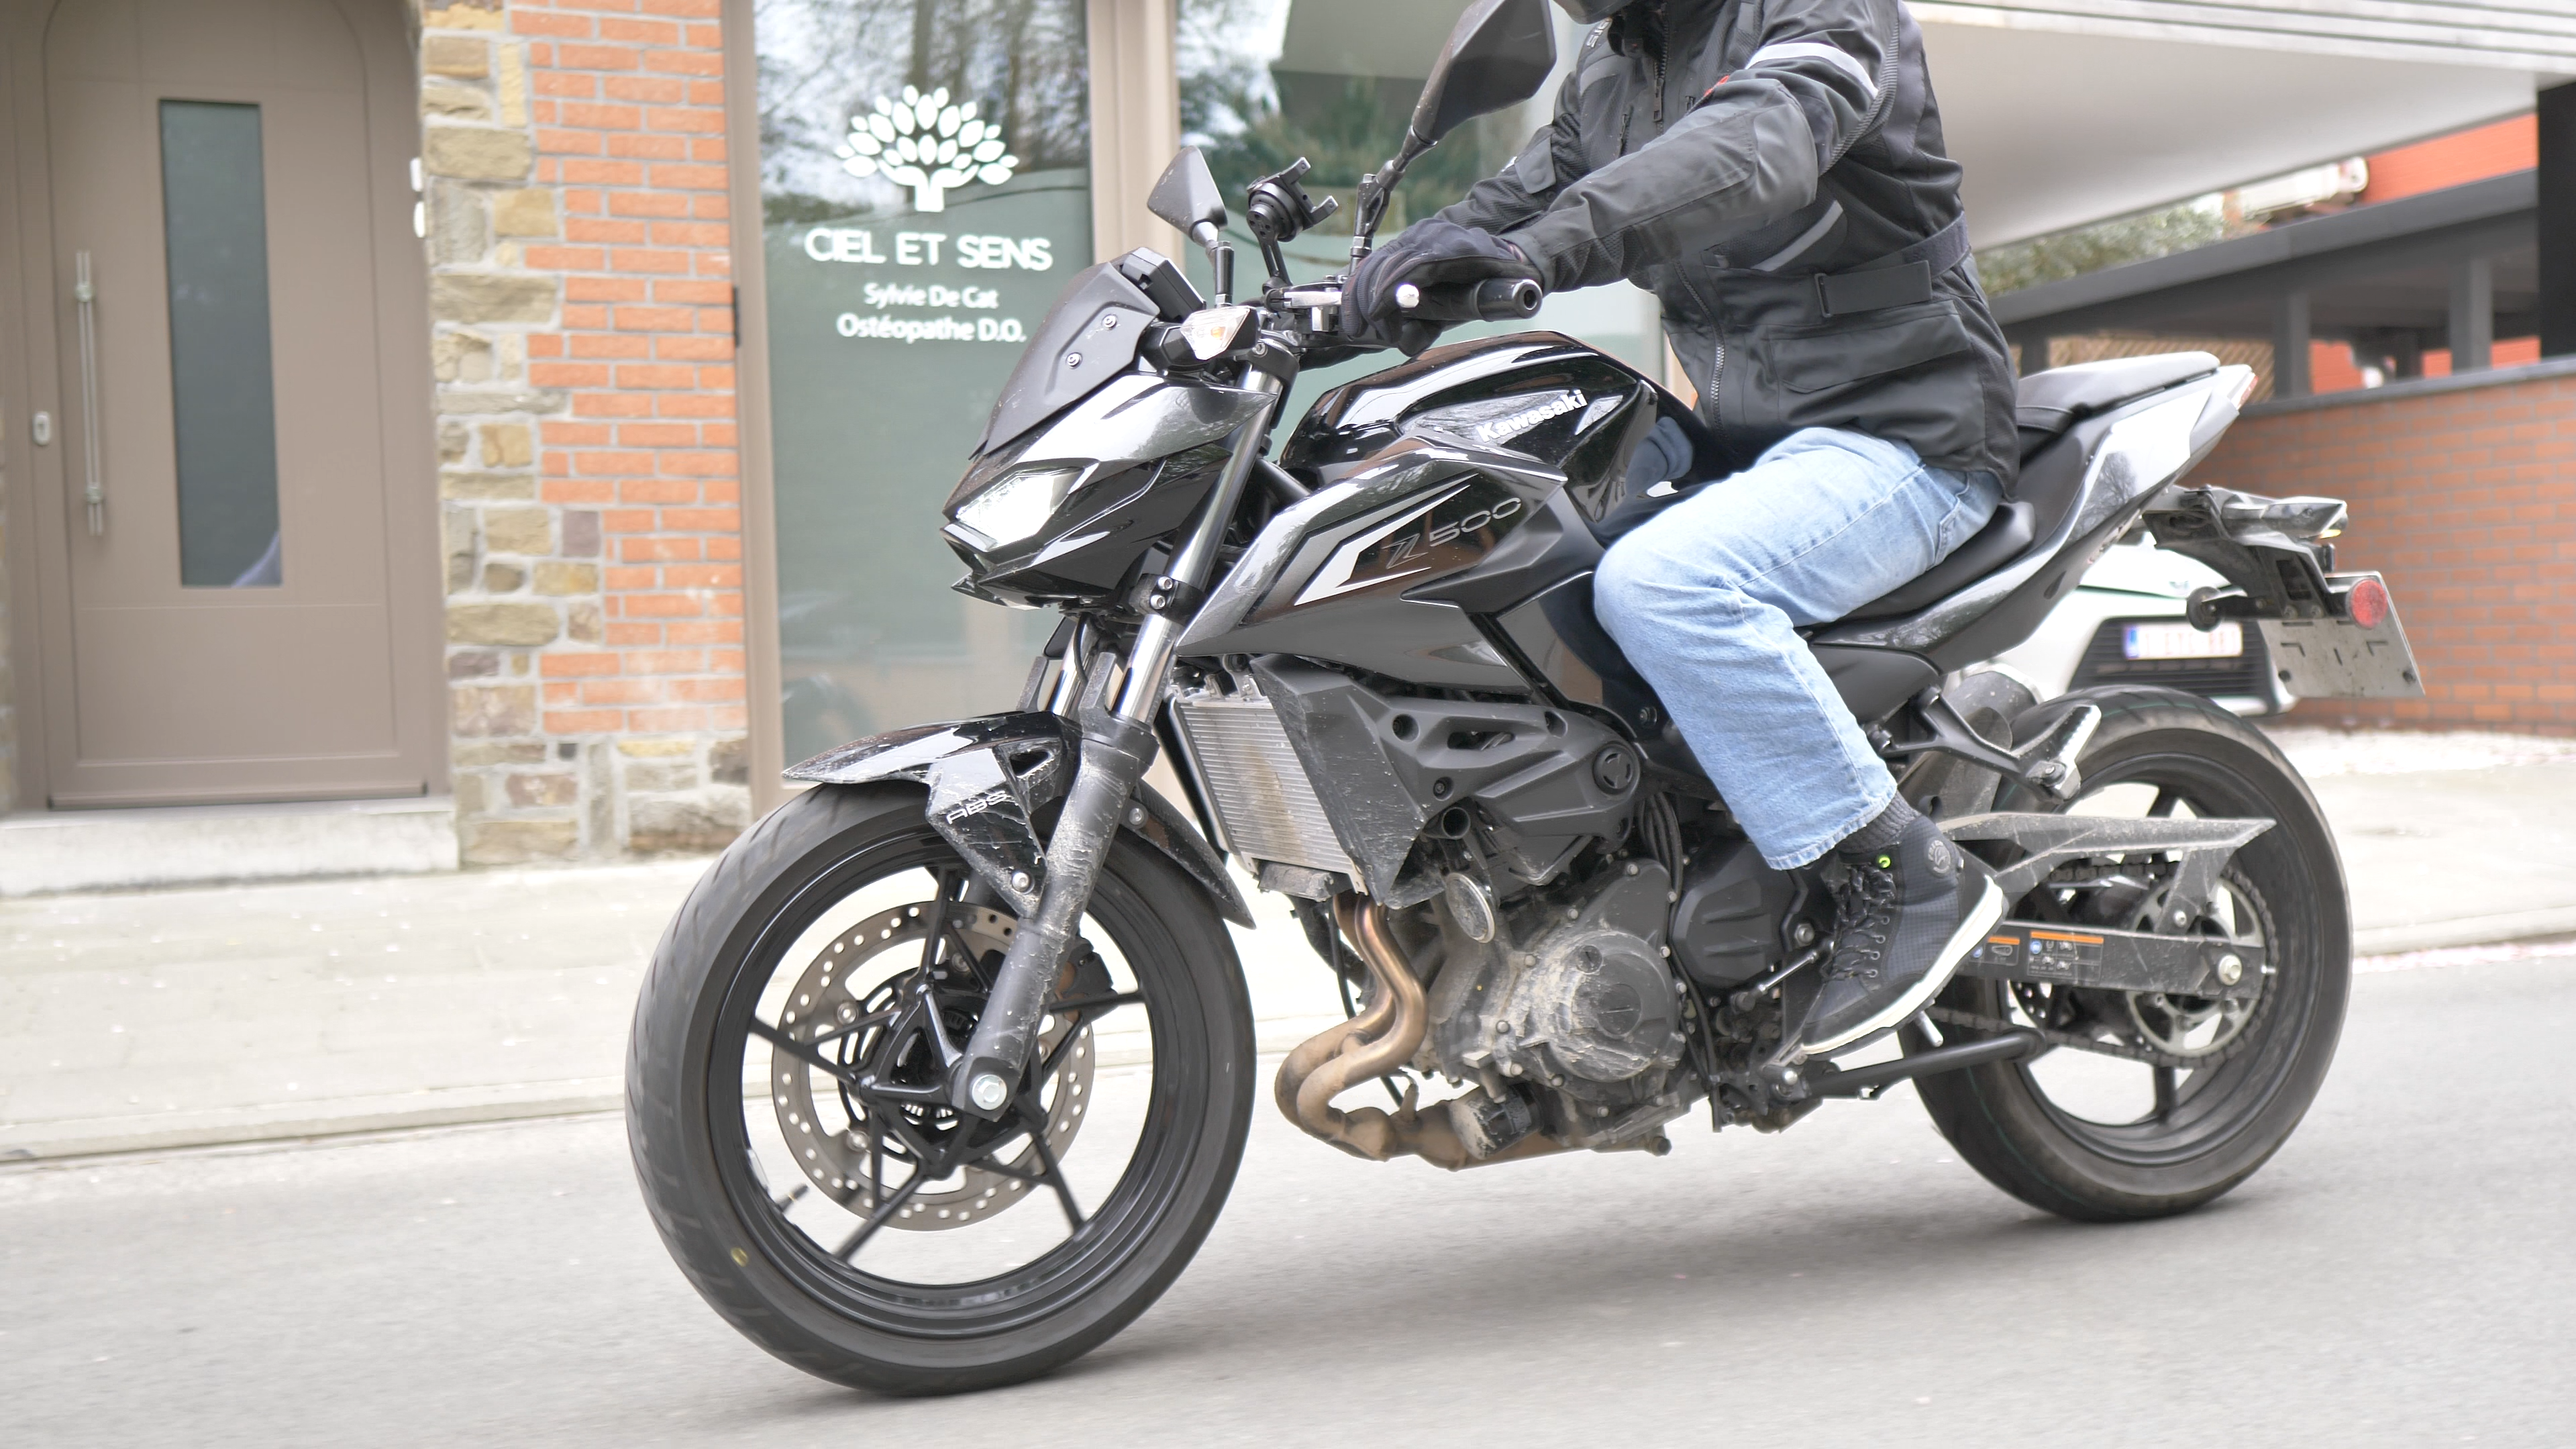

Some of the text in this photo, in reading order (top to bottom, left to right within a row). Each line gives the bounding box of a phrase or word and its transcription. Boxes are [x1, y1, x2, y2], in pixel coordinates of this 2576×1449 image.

[805, 228, 1053, 270] CIEL ET SENS
[864, 283, 999, 309] Sylvie De Cat
[836, 313, 1027, 344] Ostéopathe D.O.
[1476, 389, 1588, 442] Kawasaki
[947, 791, 1007, 824] ABS
